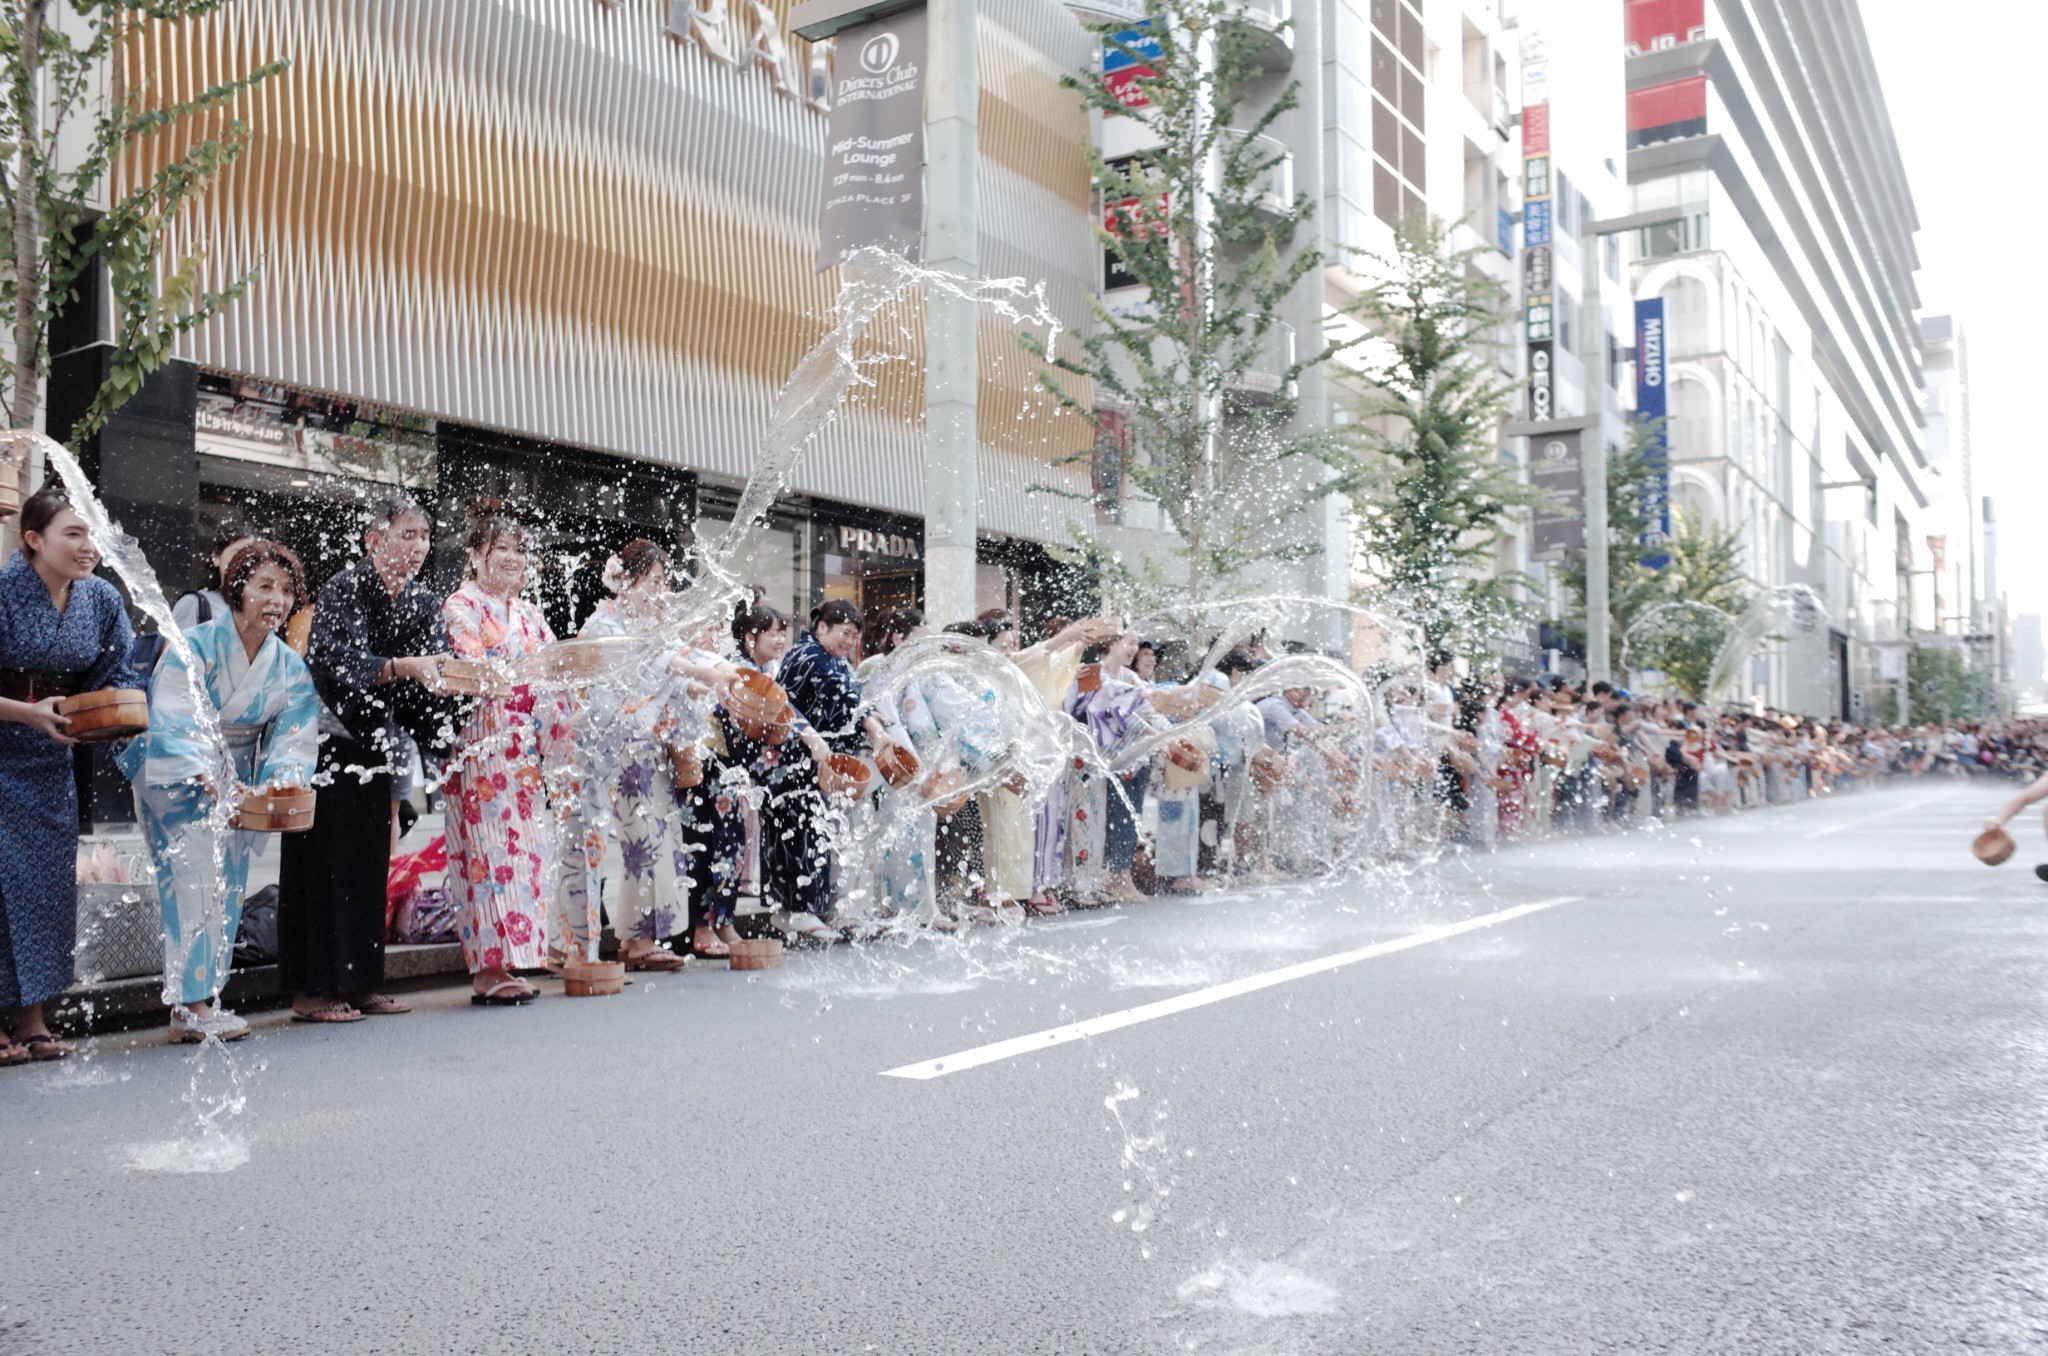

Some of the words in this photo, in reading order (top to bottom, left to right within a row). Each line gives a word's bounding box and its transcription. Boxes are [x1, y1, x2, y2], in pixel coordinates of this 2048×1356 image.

[837, 80, 917, 107] INTERNATIONAL
[839, 77, 885, 96] Diners
[886, 62, 917, 85] Club
[832, 132, 914, 156] Mid-Summer
[843, 152, 896, 167] Lounge
[856, 194, 896, 205] PLACE
[1644, 318, 1662, 387] MIZUHO
[1532, 350, 1550, 422] GEOX
[839, 525, 920, 560] PRADA
